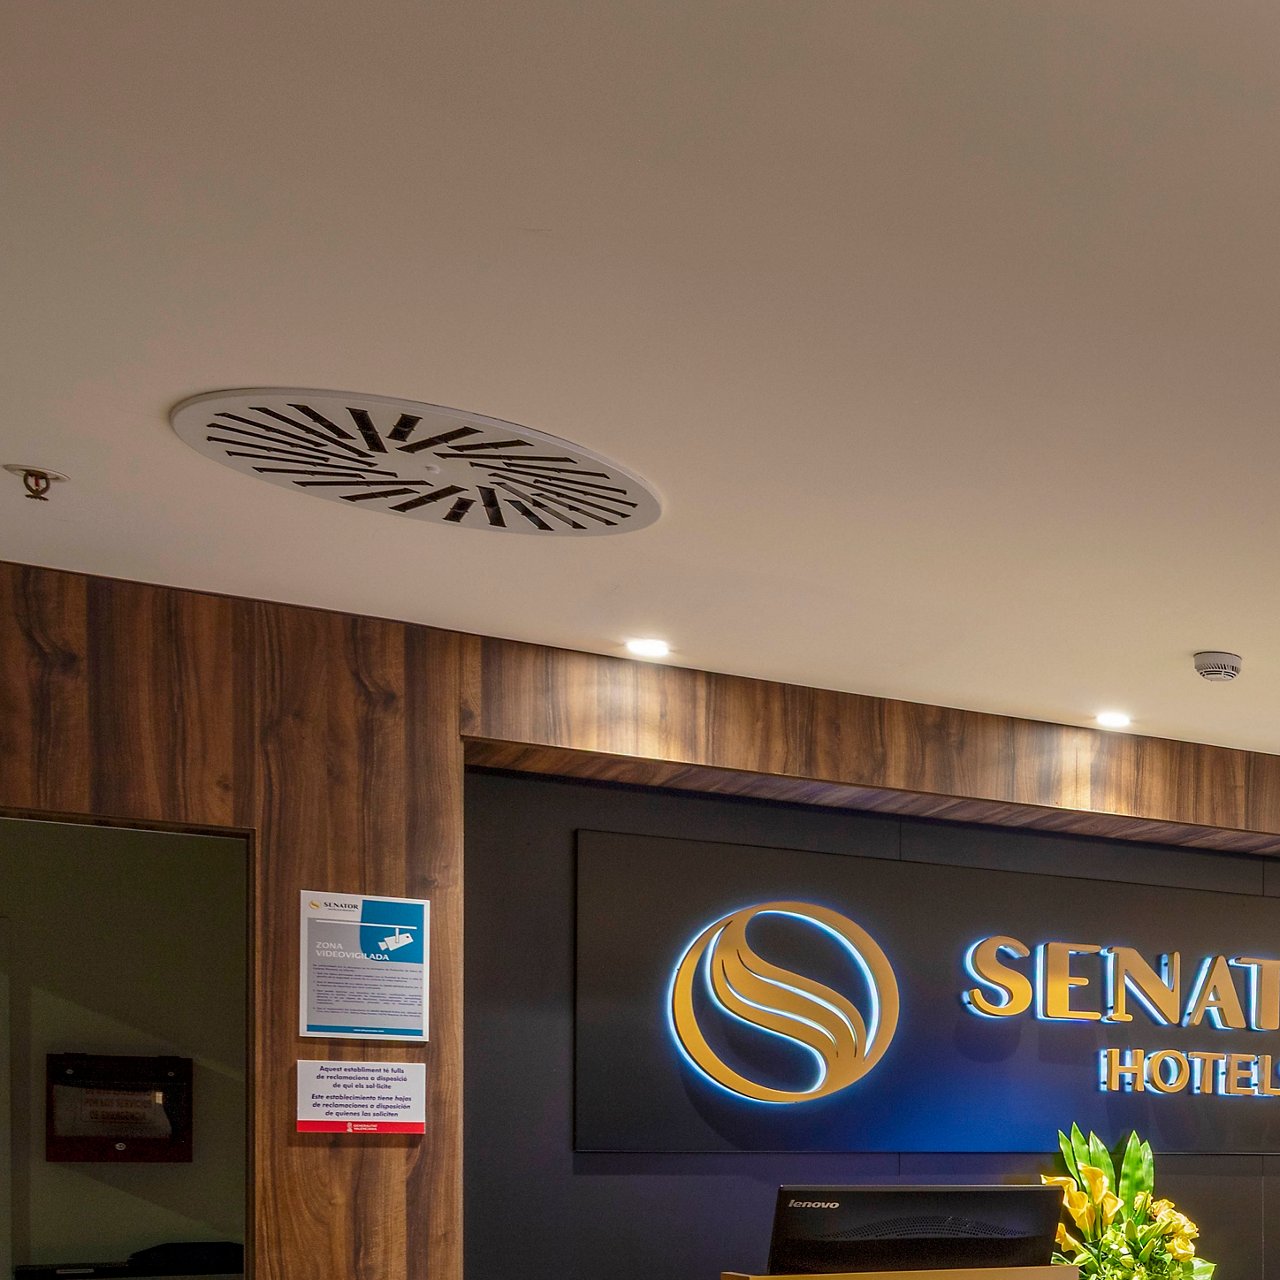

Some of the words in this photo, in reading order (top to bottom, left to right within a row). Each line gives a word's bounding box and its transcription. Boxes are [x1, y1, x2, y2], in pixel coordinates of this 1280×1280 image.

[323, 901, 359, 910] SENATOR
[316, 941, 343, 950] ZONA
[316, 950, 390, 961] VIDEOVIGILADA
[789, 1200, 840, 1208] lenovo
